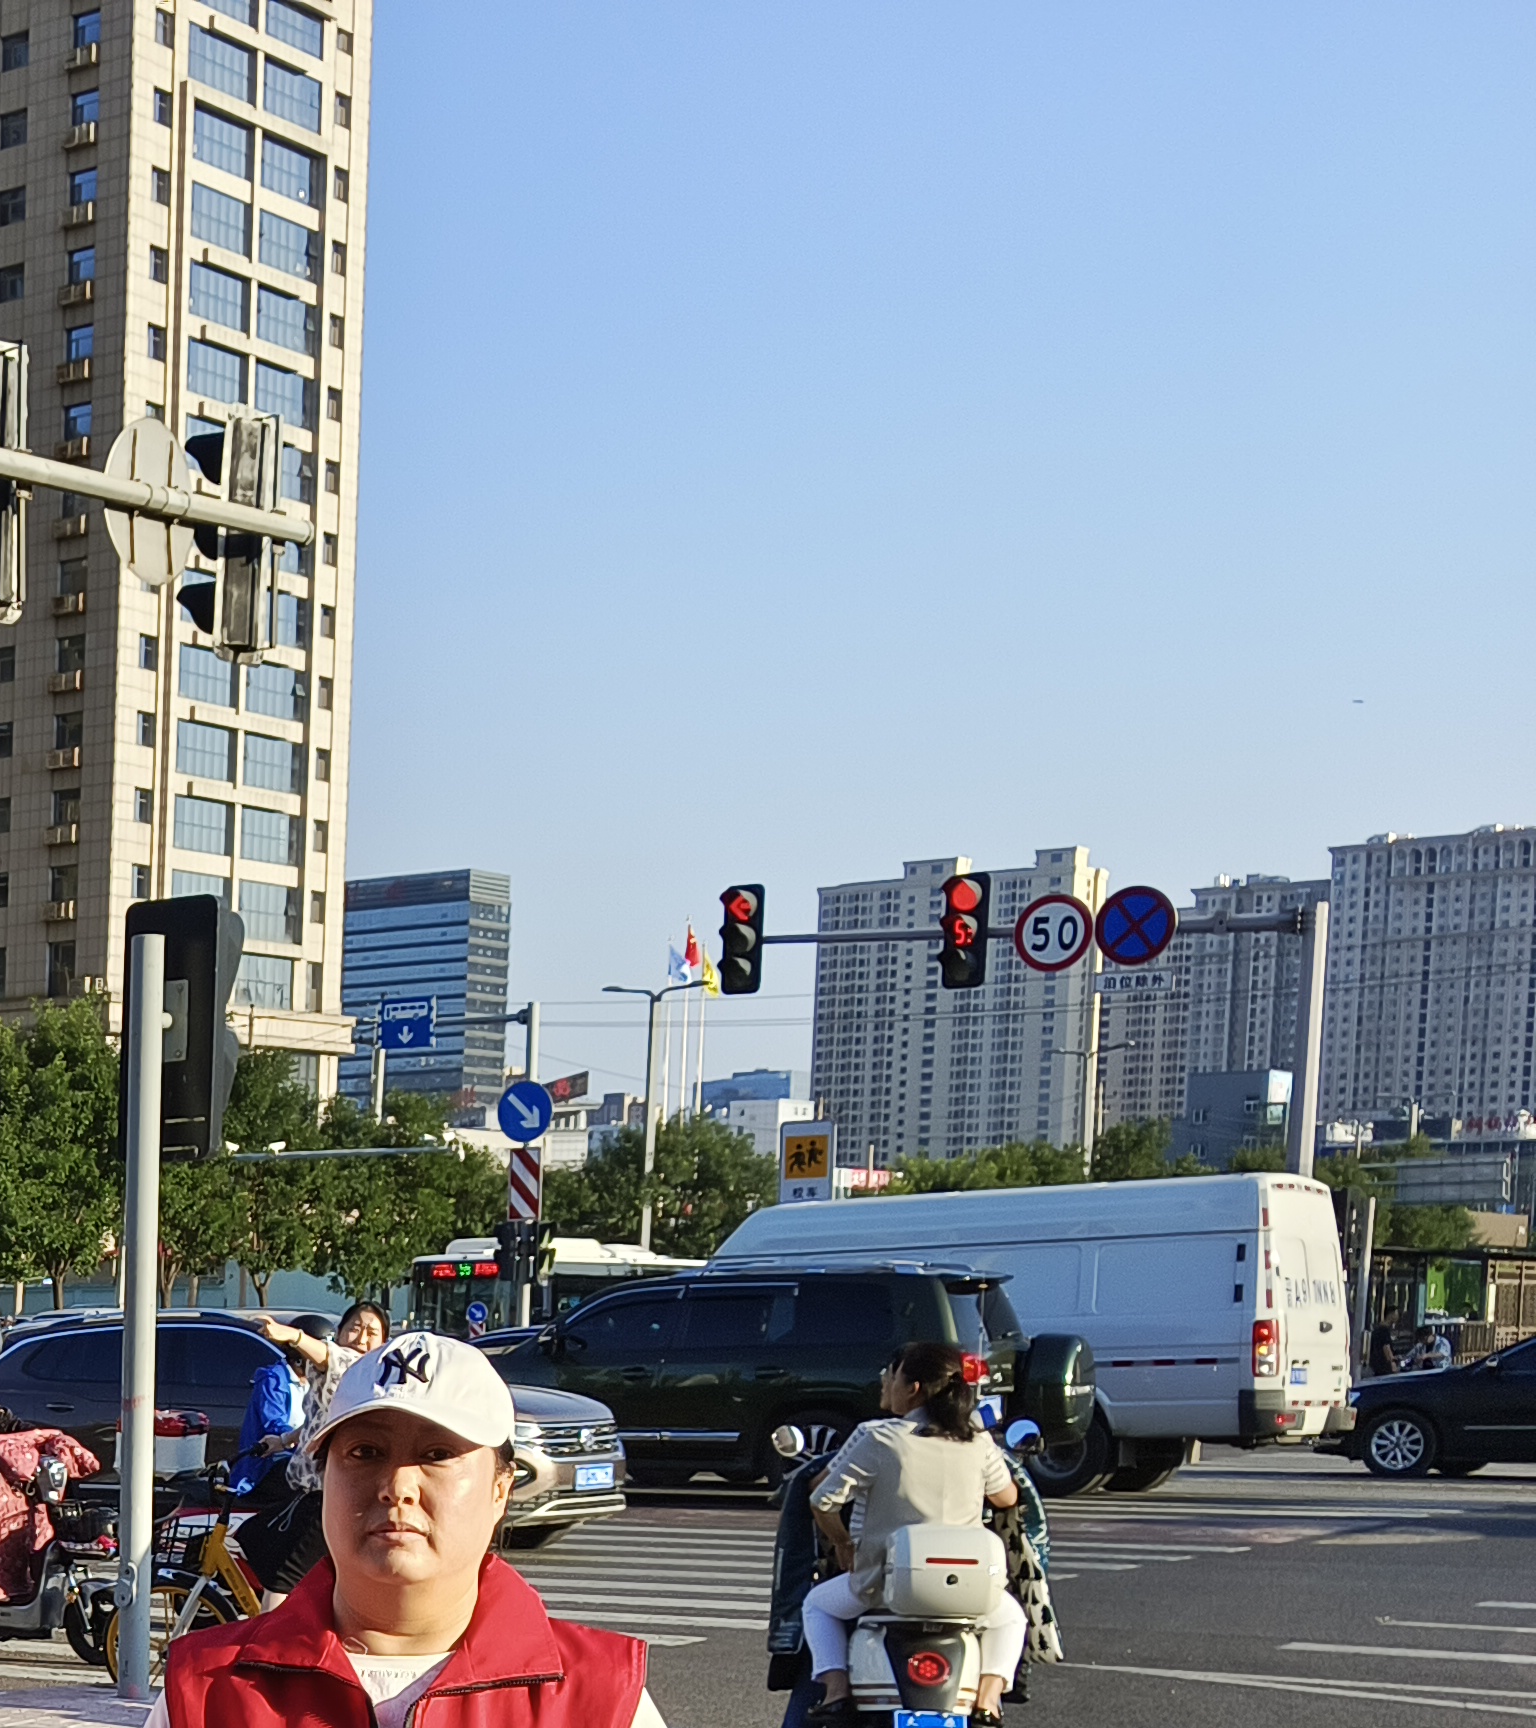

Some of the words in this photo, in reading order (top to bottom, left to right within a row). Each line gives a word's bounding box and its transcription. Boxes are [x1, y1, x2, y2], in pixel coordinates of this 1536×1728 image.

[1032, 916, 1078, 951] 50
[1103, 973, 1166, 990] 泊位除外
[379, 1348, 431, 1386] NY
